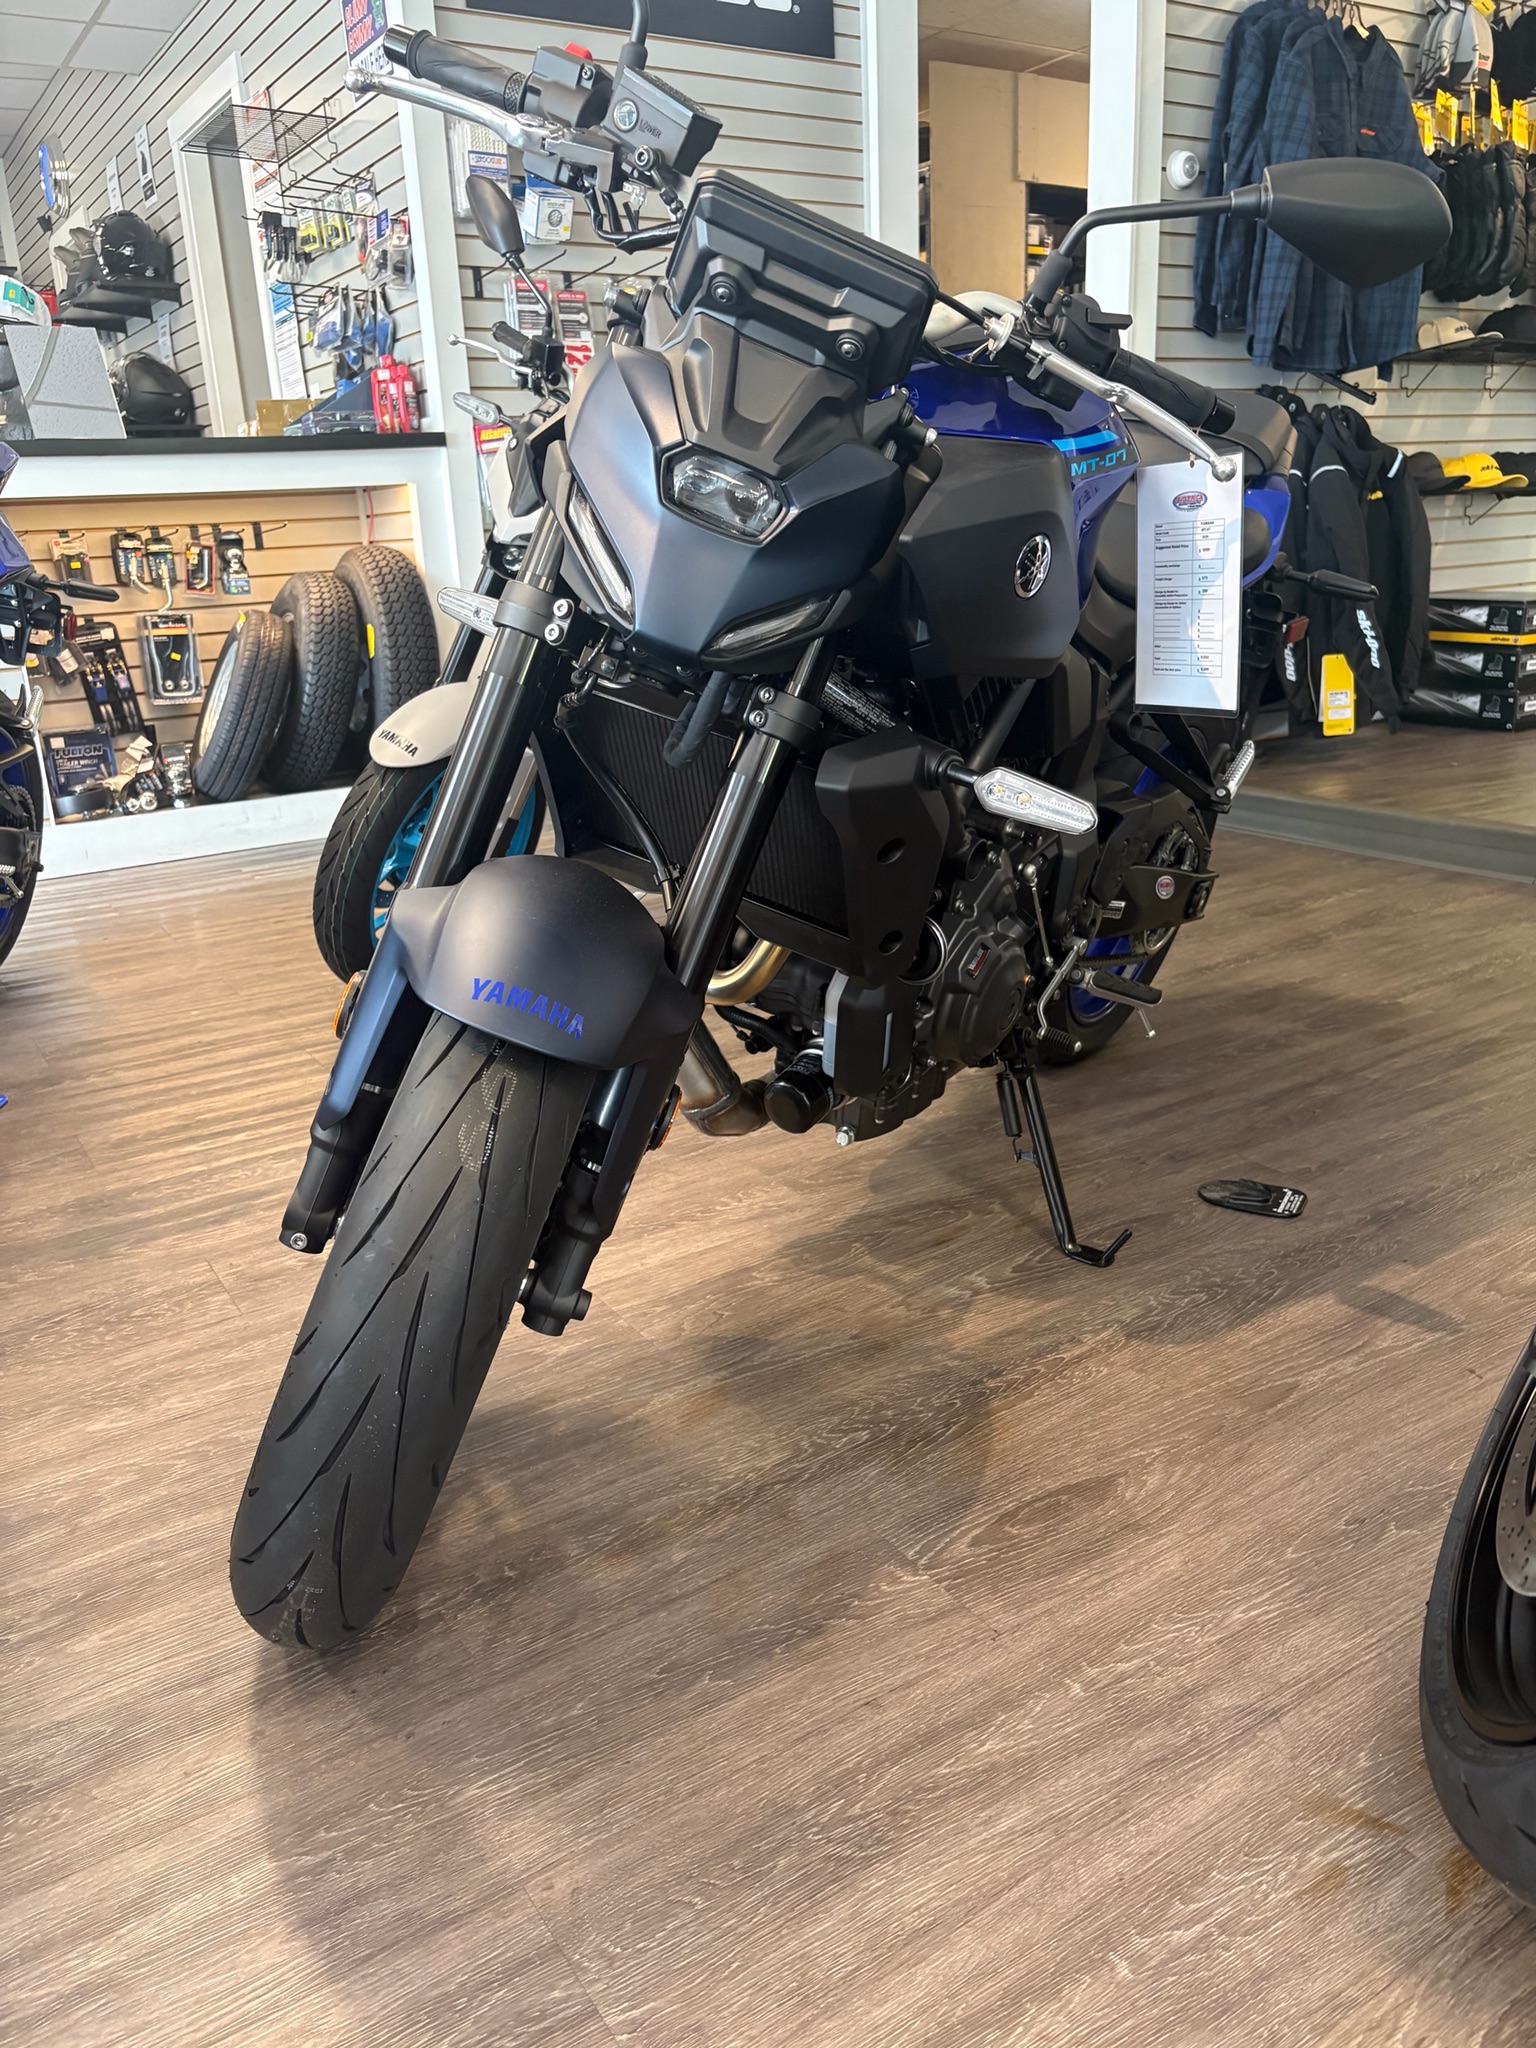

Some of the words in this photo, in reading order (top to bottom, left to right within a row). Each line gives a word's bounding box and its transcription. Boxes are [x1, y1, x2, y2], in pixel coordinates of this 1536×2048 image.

[640, 119, 662, 140] LOWER
[1070, 449, 1127, 477] MT-07
[378, 729, 419, 757] YAMAHA
[471, 977, 584, 1041] YAMAHA
